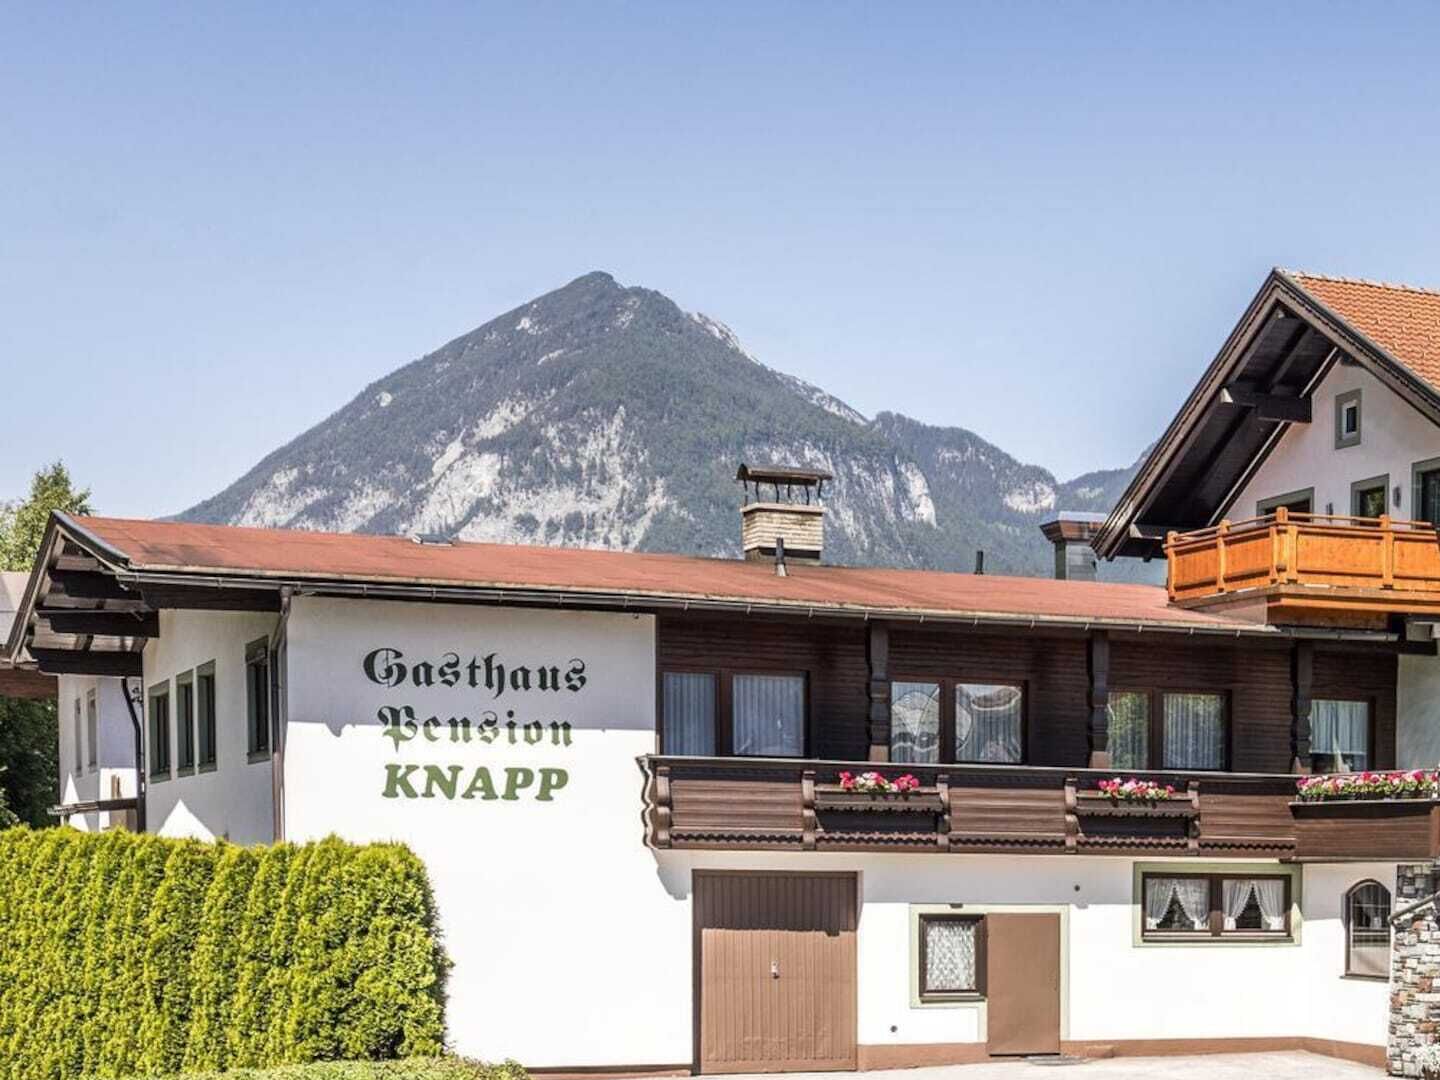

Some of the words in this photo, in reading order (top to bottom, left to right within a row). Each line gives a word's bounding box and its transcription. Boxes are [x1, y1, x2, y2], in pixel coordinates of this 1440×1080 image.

[363, 647, 587, 699] Gasthaus
[377, 705, 573, 752] Pension
[381, 764, 569, 801] KNAPP
